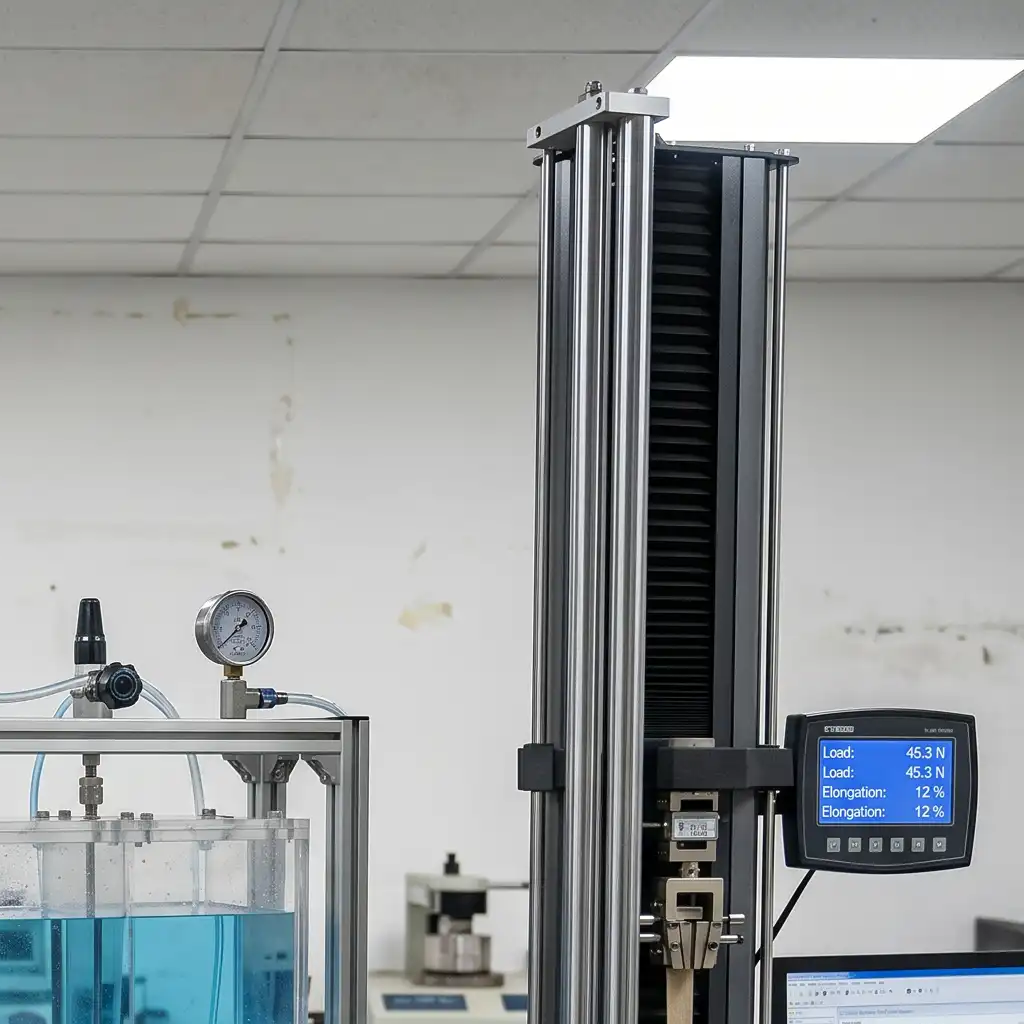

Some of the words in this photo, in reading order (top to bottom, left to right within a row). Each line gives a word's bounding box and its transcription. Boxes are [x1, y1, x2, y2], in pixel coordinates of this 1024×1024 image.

[823, 746, 854, 759] Load:
[906, 747, 933, 759] 45.3
[936, 747, 945, 759] N
[823, 766, 854, 779] Load:
[905, 766, 933, 779] 45.3
[935, 766, 945, 778] N
[822, 786, 887, 800] Elongation:
[915, 786, 930, 798] 12
[933, 785, 945, 798] %
[822, 805, 885, 820] Elongation:
[915, 805, 930, 817] 12
[932, 805, 945, 817] %
